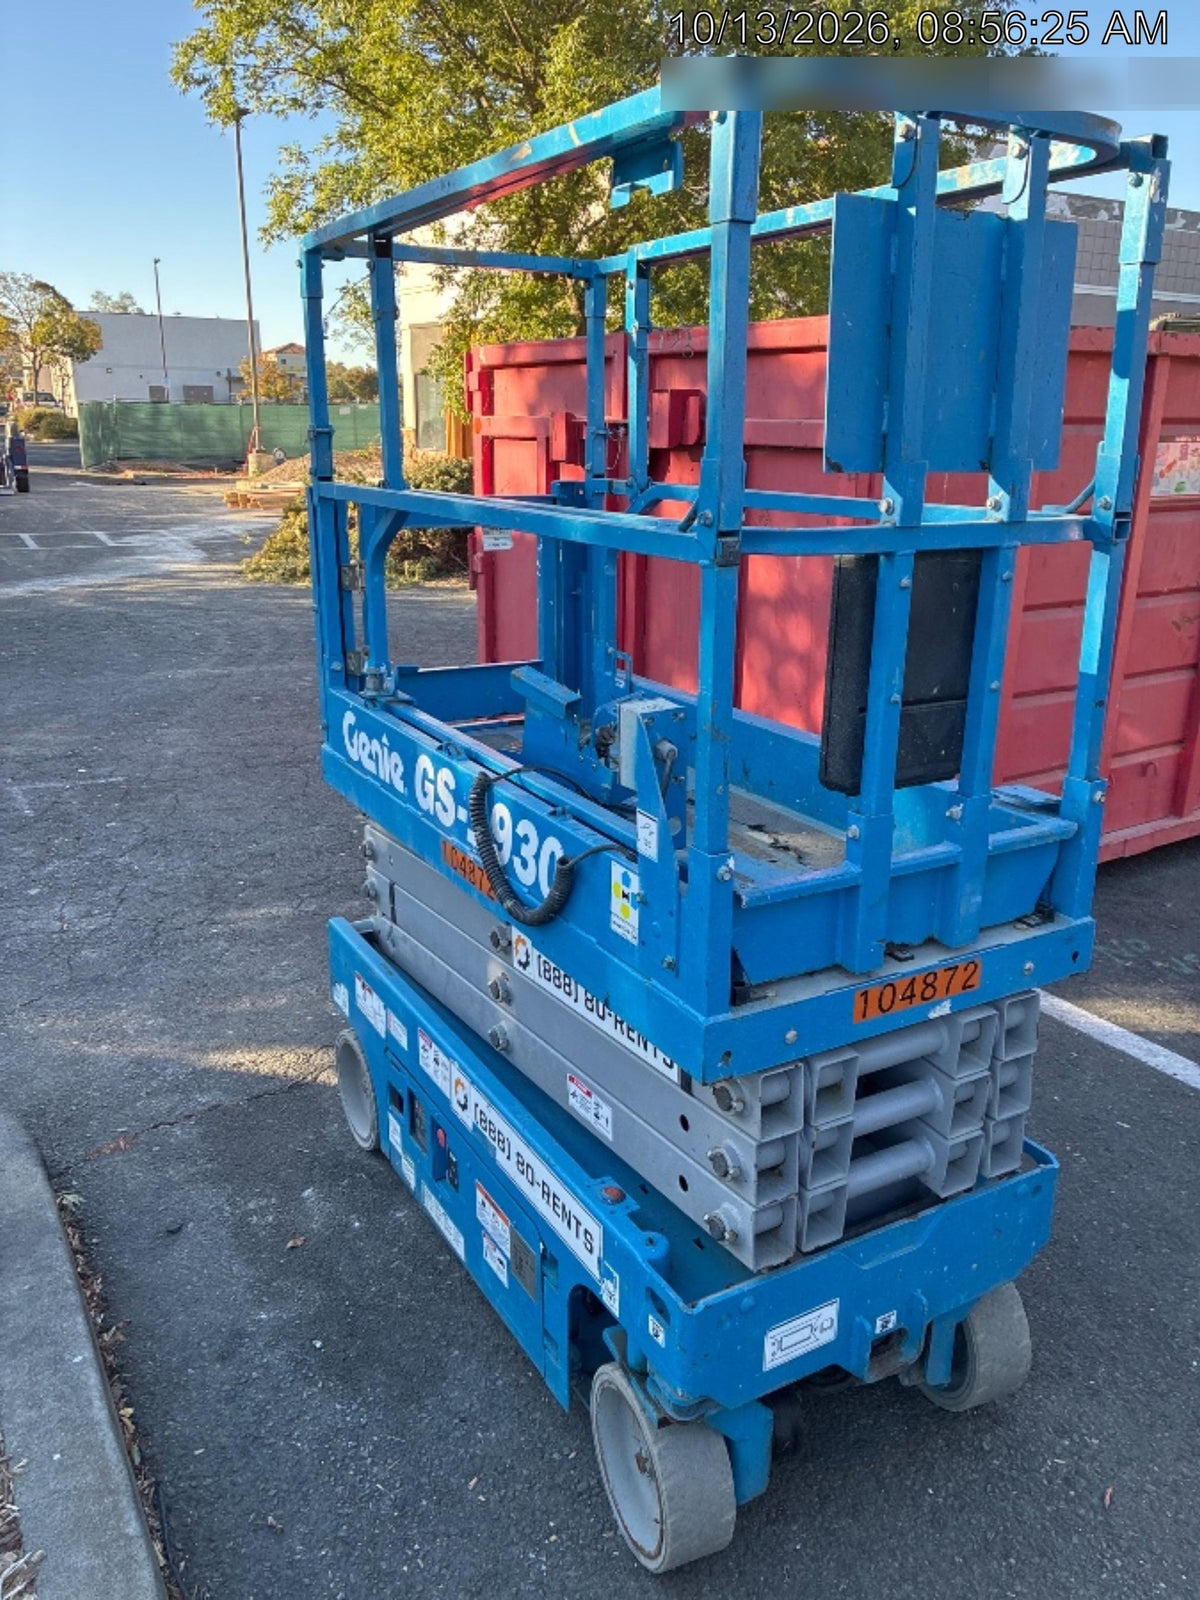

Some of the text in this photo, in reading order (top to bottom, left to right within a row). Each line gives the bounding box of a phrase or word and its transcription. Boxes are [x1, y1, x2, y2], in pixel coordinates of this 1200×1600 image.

[342, 710, 405, 794] Genie
[414, 753, 564, 899] GS-930
[859, 959, 979, 1020] 104872
[516, 1151, 594, 1255] 80-RENTS
